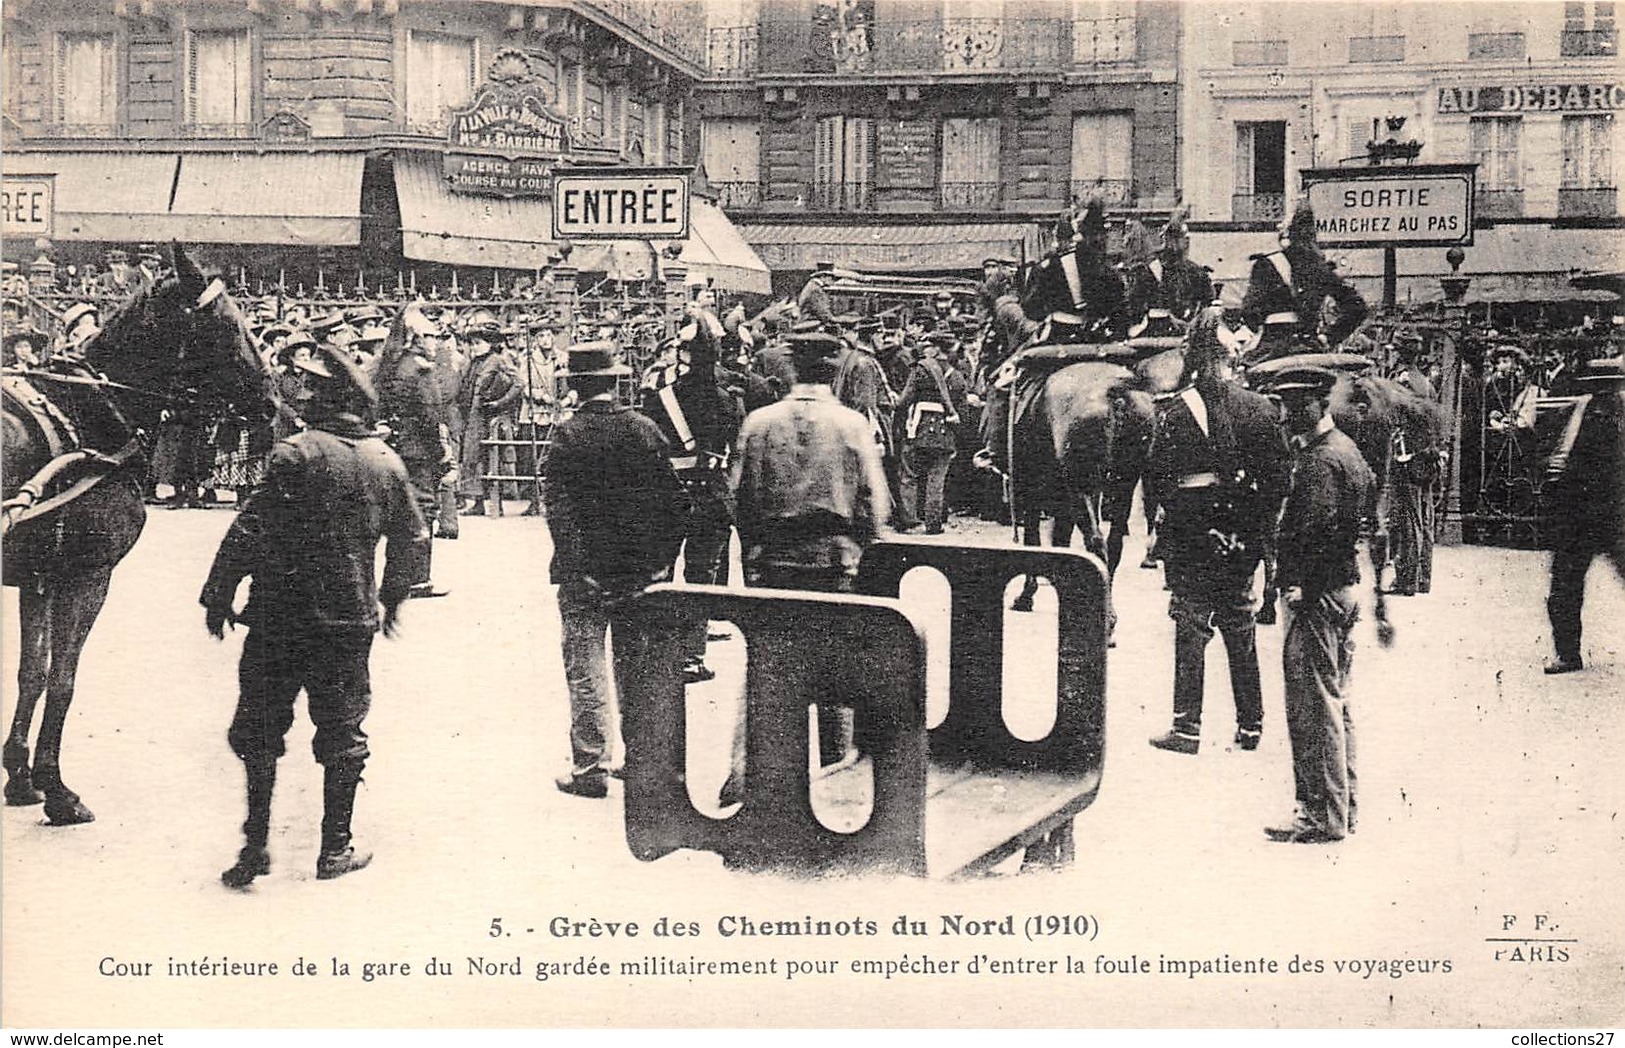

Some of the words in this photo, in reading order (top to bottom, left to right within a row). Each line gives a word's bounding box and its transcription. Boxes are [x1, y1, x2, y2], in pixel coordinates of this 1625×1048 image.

[1437, 87, 1480, 112] AU
[462, 160, 511, 173] AGENCE
[452, 175, 498, 187] COURSE
[564, 184, 677, 224] ENTRÉE
[1344, 188, 1430, 208] SORTIE
[1316, 217, 1391, 233] MARCHEZ
[1398, 216, 1419, 232] AU
[1428, 215, 1458, 231] PAS
